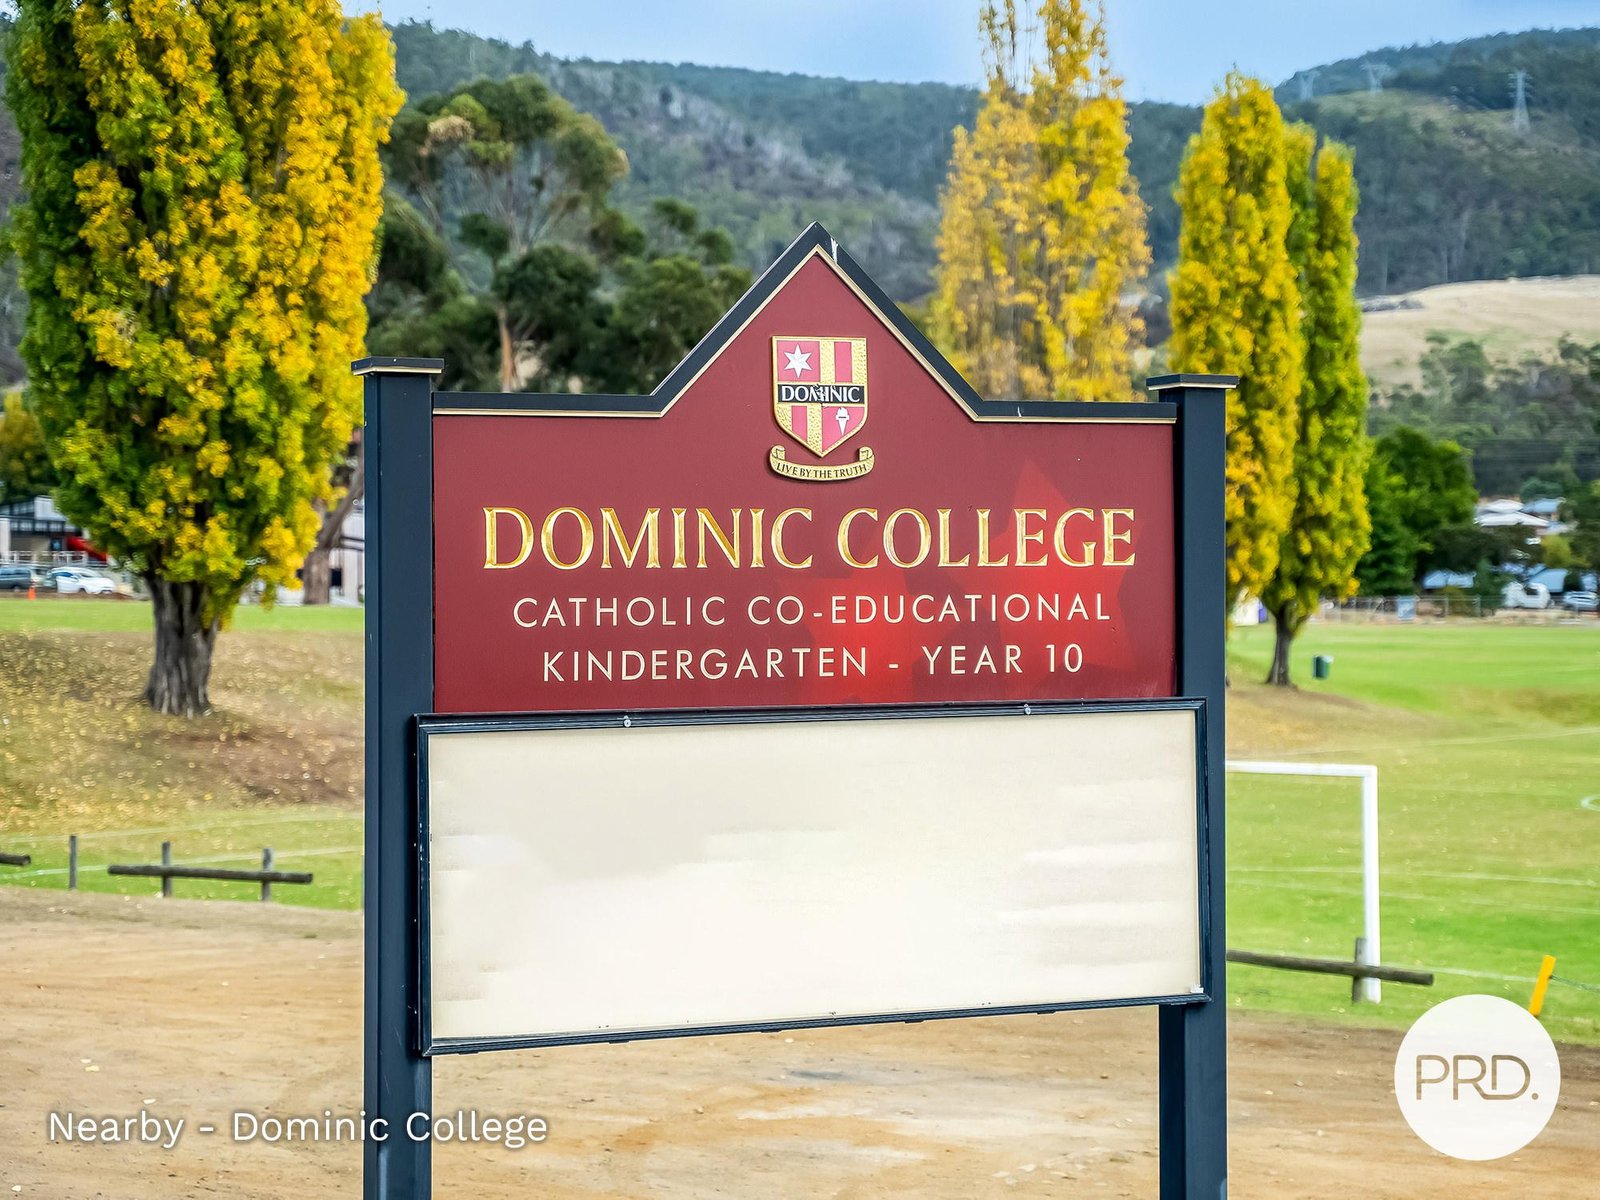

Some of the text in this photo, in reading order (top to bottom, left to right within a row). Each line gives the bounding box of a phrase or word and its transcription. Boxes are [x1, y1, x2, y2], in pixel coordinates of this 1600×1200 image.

[776, 462, 798, 476] LIVE
[799, 466, 812, 478] BY
[812, 467, 832, 479] THE
[483, 507, 1136, 570] DOMINIC COLLEGE
[513, 593, 1110, 628] CATHOLIC CO-EDUCATIONAL
[543, 647, 867, 682] KINDERGARTEN
[921, 645, 1023, 675] YEAR
[1045, 643, 1083, 673] 10
